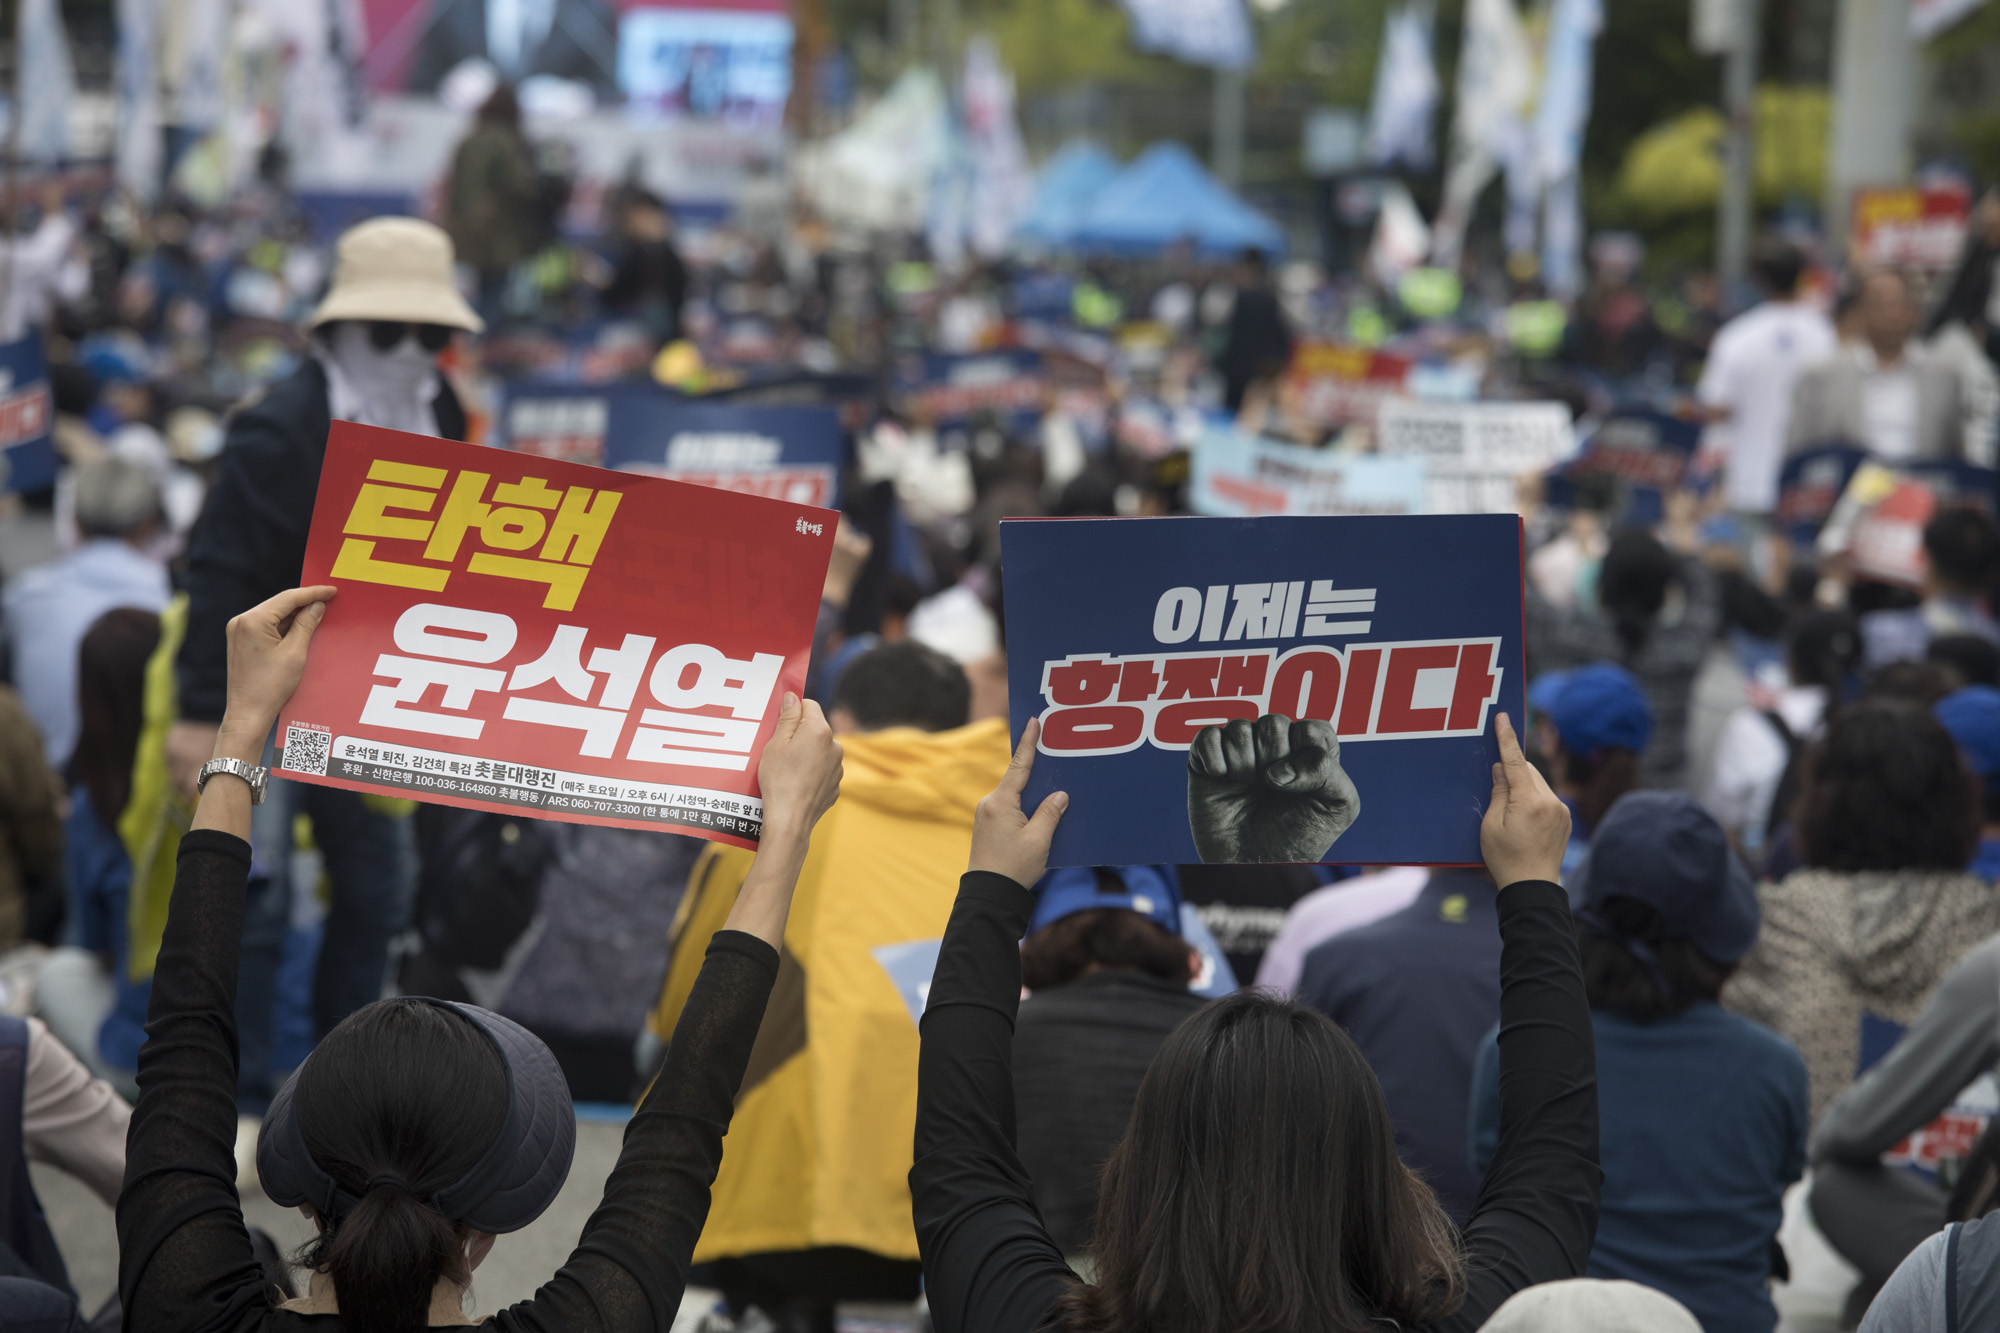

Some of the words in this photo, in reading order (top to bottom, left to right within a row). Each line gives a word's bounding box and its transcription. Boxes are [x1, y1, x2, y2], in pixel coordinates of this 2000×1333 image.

[329, 459, 623, 612] 탄핵
[795, 516, 823, 537] 촛불행동
[1153, 579, 1377, 644] 이제는
[358, 603, 785, 771] 윤석열
[1036, 636, 1504, 757] 항쟁이다
[341, 762, 363, 776] 후원
[371, 767, 413, 784] 신한은행
[415, 774, 496, 797] 100-036-164860
[498, 787, 540, 803] 촛불행동
[547, 795, 569, 807] ARS
[570, 798, 641, 815] 060-707-3300
[642, 805, 657, 818] (한
[658, 808, 680, 821] 통에
[682, 810, 699, 822] 1만
[700, 812, 714, 826] 원,
[716, 815, 736, 830] 여러
[738, 820, 748, 833] 번
[749, 823, 761, 836] 가
[344, 744, 379, 762] 윤석열
[381, 749, 409, 767] 퇴진,
[412, 755, 446, 772] 김건희
[448, 761, 472, 776] 특검
[474, 761, 557, 789] 촛불대행진
[560, 780, 585, 793] (매주
[587, 784, 618, 798] 토요일
[626, 789, 648, 801] 오후
[650, 791, 668, 803] 6시
[676, 794, 741, 814] 시청역-숭례문
[742, 804, 753, 817] 앞
